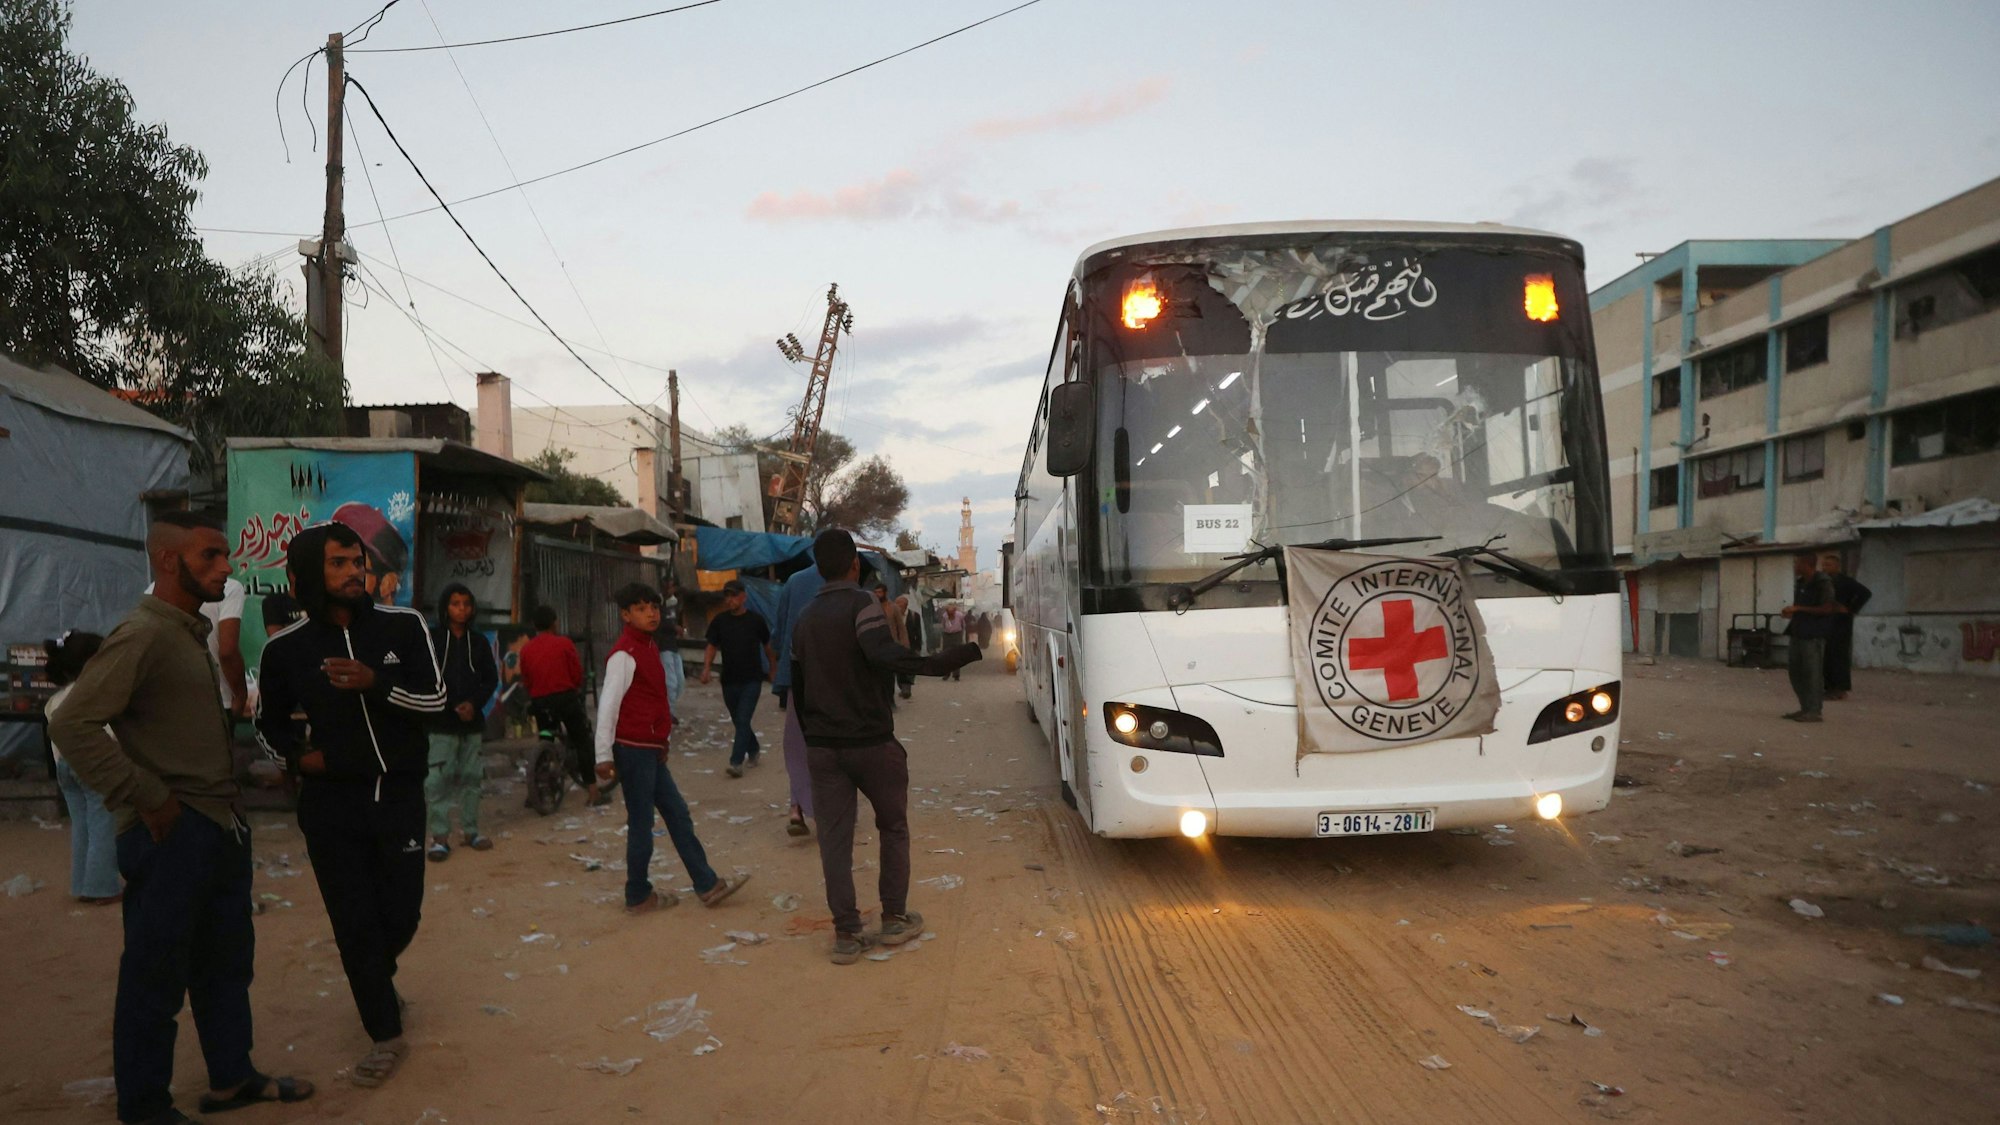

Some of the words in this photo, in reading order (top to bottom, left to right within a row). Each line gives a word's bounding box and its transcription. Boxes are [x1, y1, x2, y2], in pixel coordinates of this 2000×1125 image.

[1196, 519, 1221, 529] BUS
[1225, 519, 1240, 529] 22
[1316, 597, 1351, 700] COMITE
[1351, 696, 1455, 734] GENEVE
